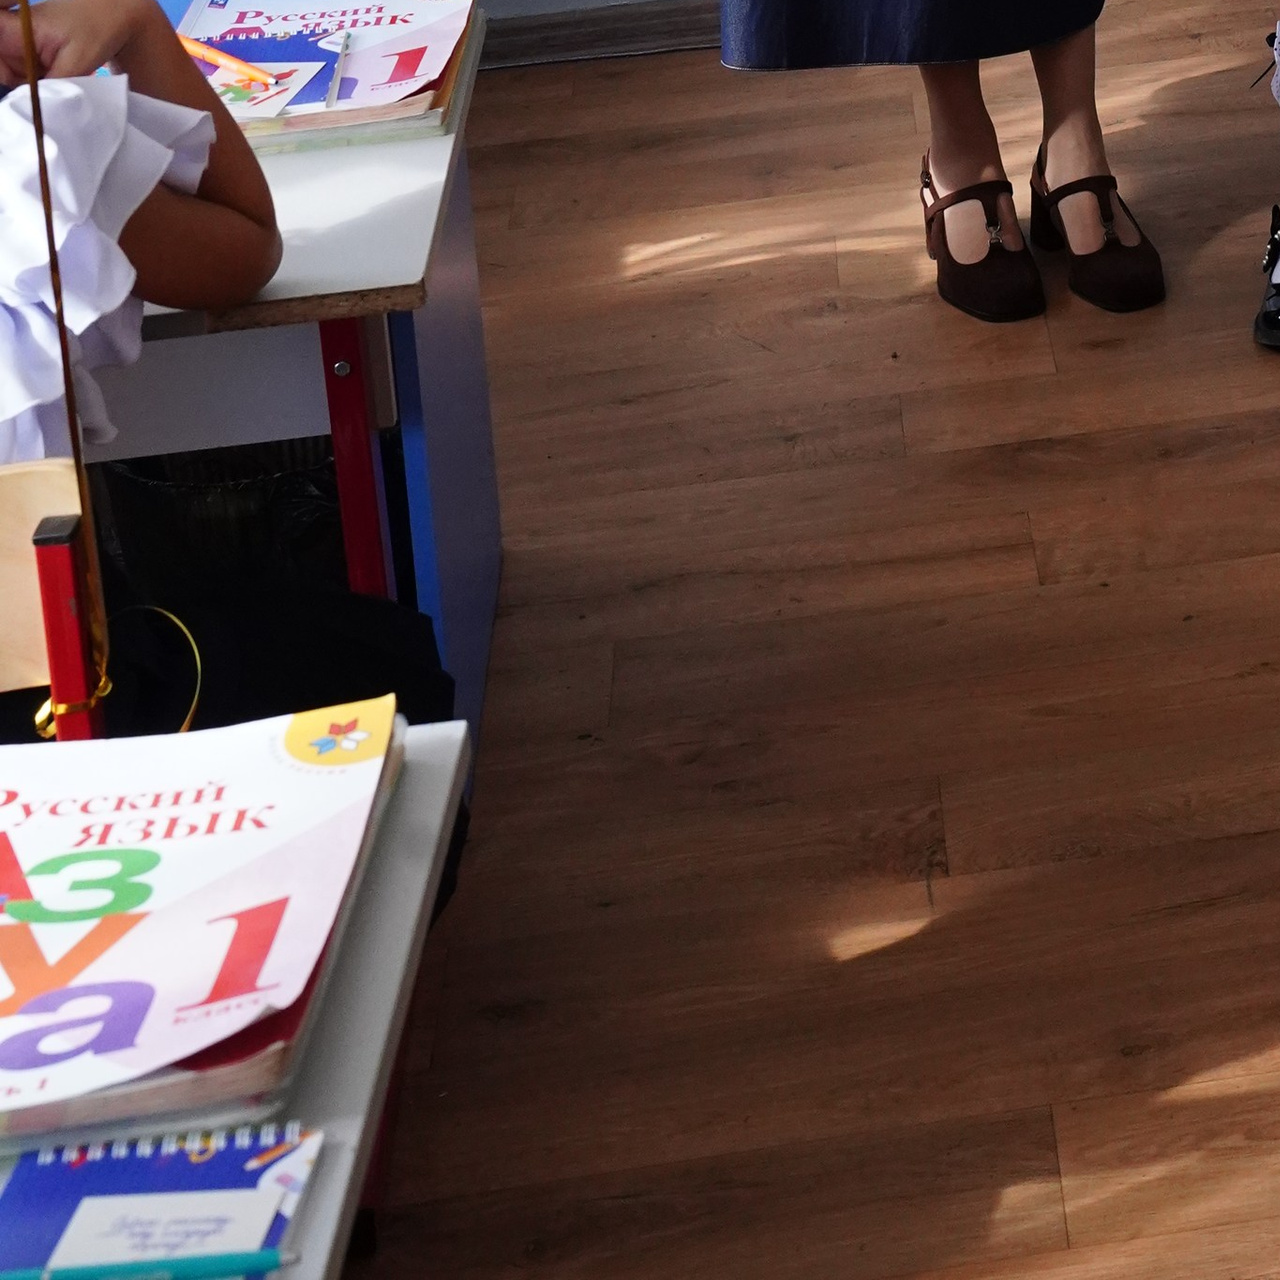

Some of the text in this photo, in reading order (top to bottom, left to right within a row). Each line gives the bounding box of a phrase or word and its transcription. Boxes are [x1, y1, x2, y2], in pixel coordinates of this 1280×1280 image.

[230, 4, 387, 26] Русский
[370, 45, 429, 87] 1
[174, 896, 290, 1013] 1
